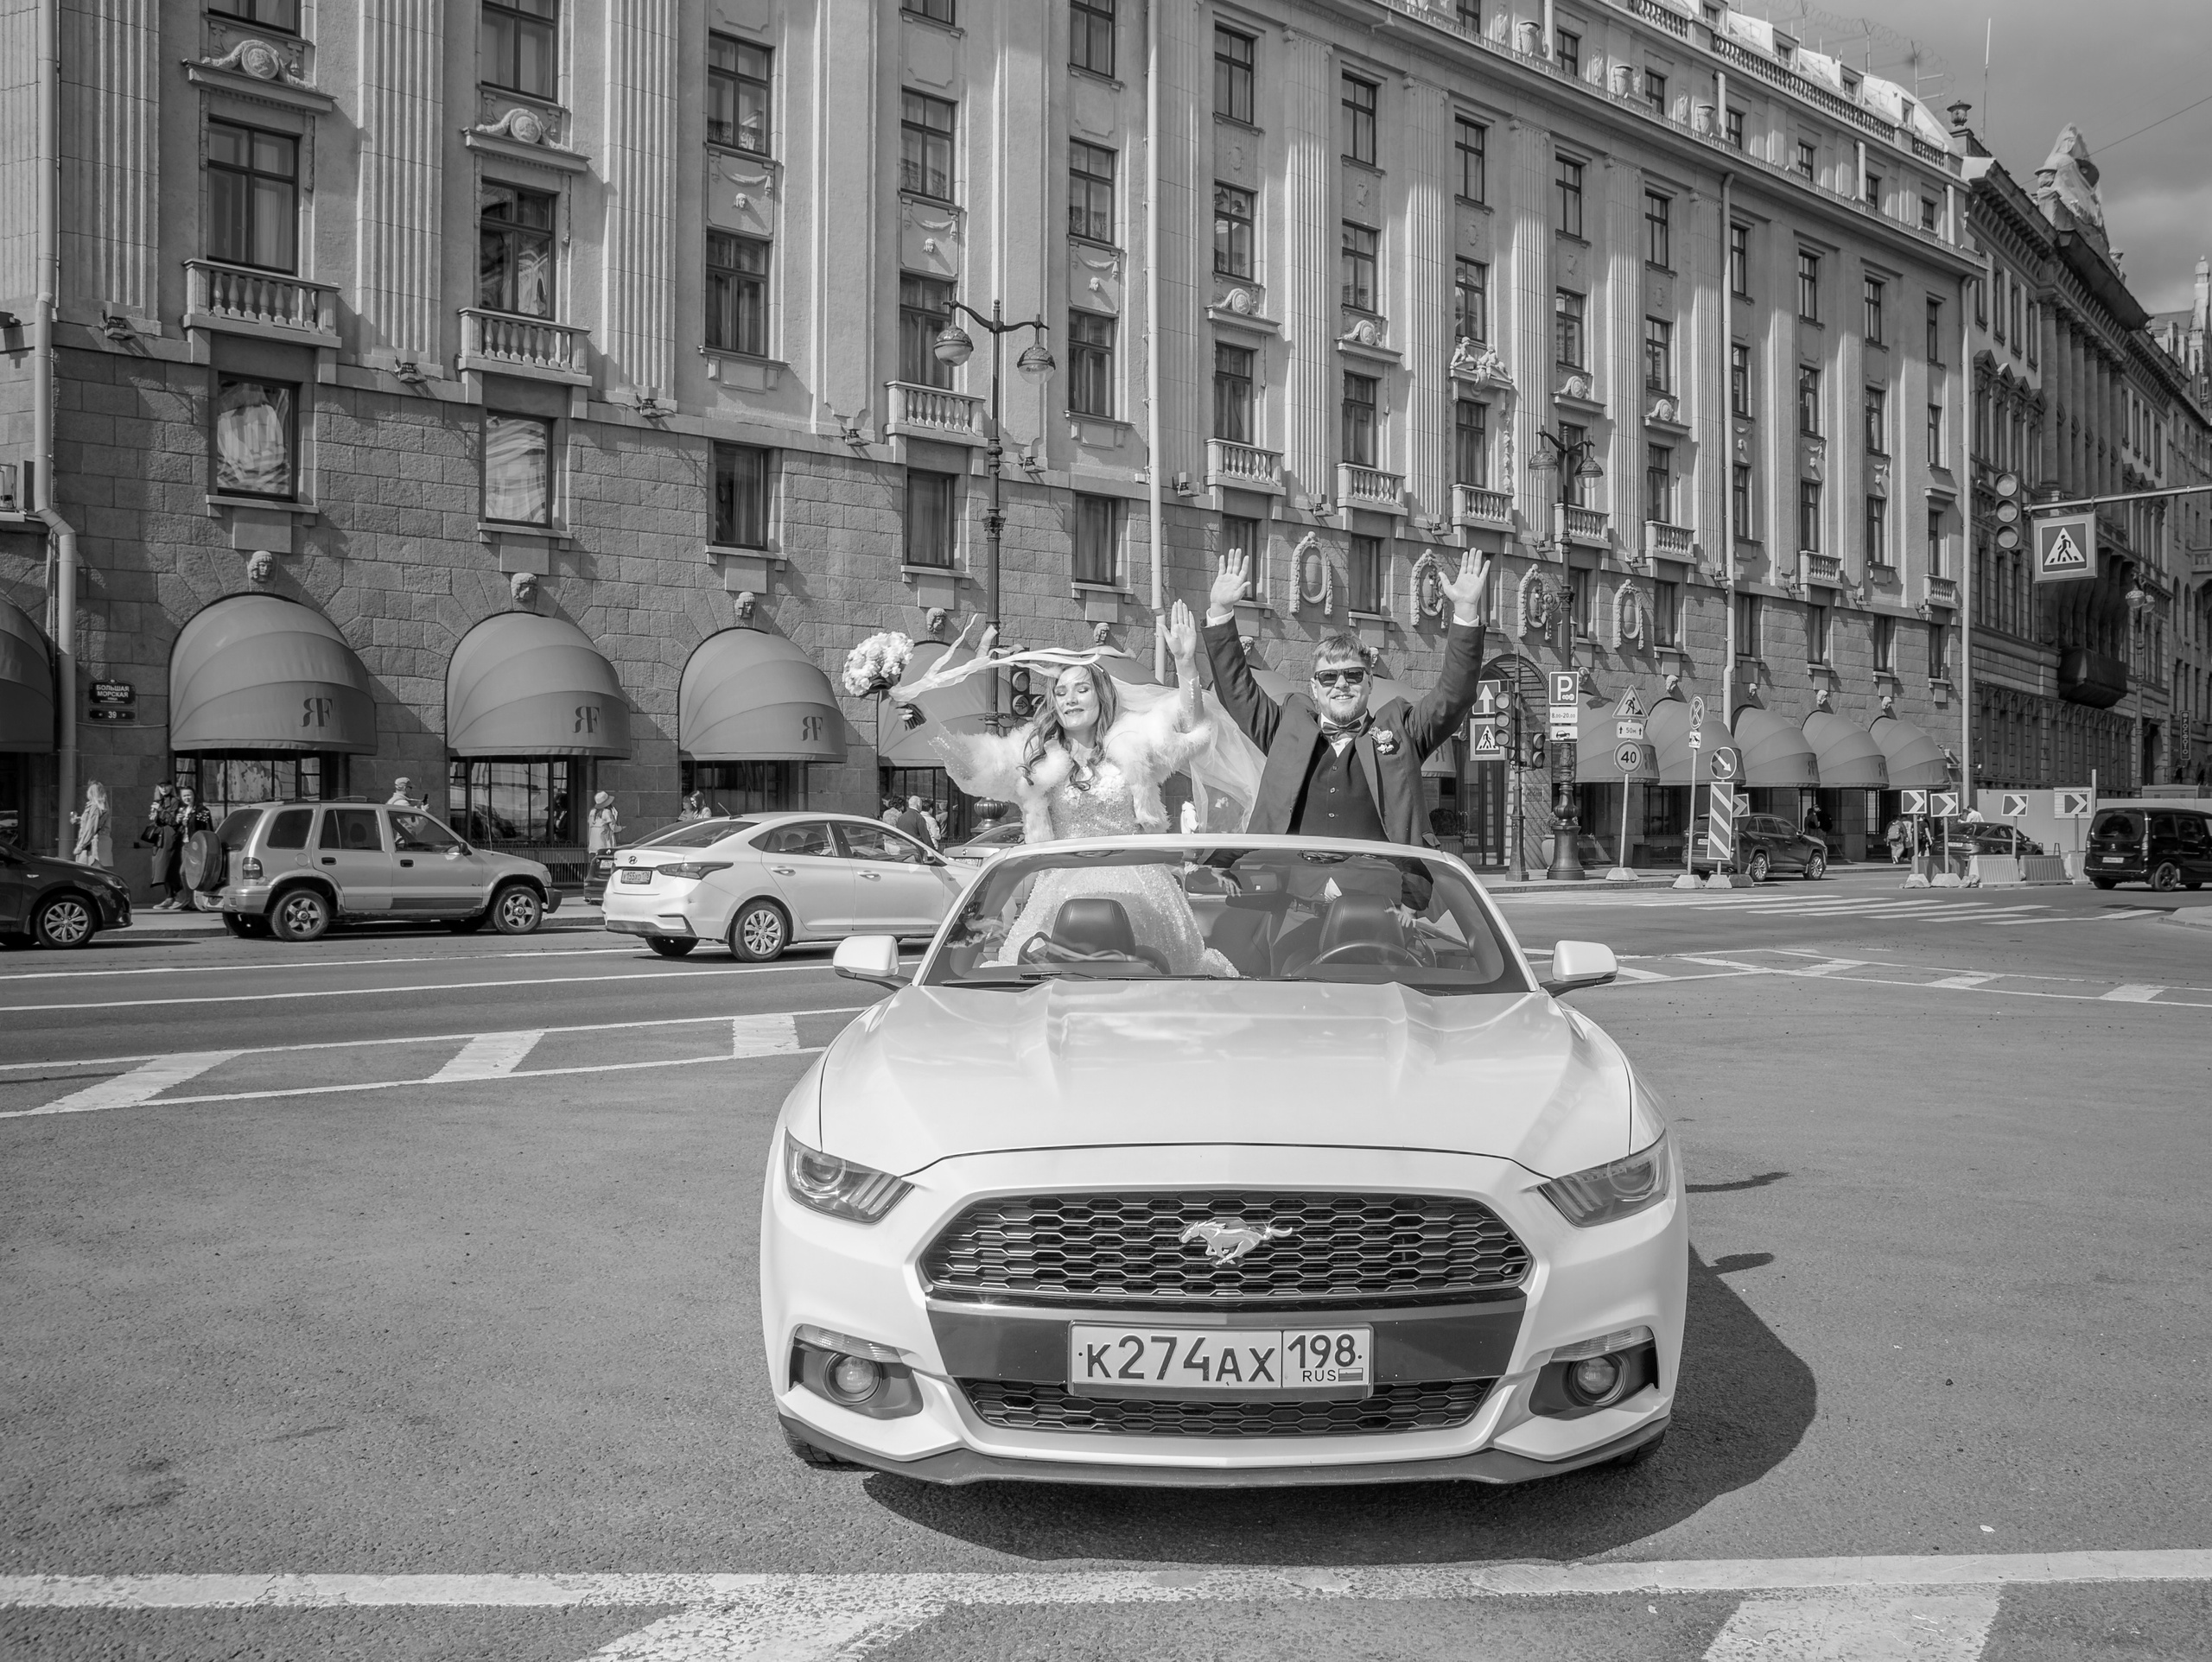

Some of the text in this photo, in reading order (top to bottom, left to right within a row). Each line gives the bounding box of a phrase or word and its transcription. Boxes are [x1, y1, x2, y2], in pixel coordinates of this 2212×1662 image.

[1557, 676, 1573, 701] P
[1620, 751, 1637, 764] 40
[1287, 1333, 1356, 1369] 198
[1302, 1369, 1337, 1382] RUS
